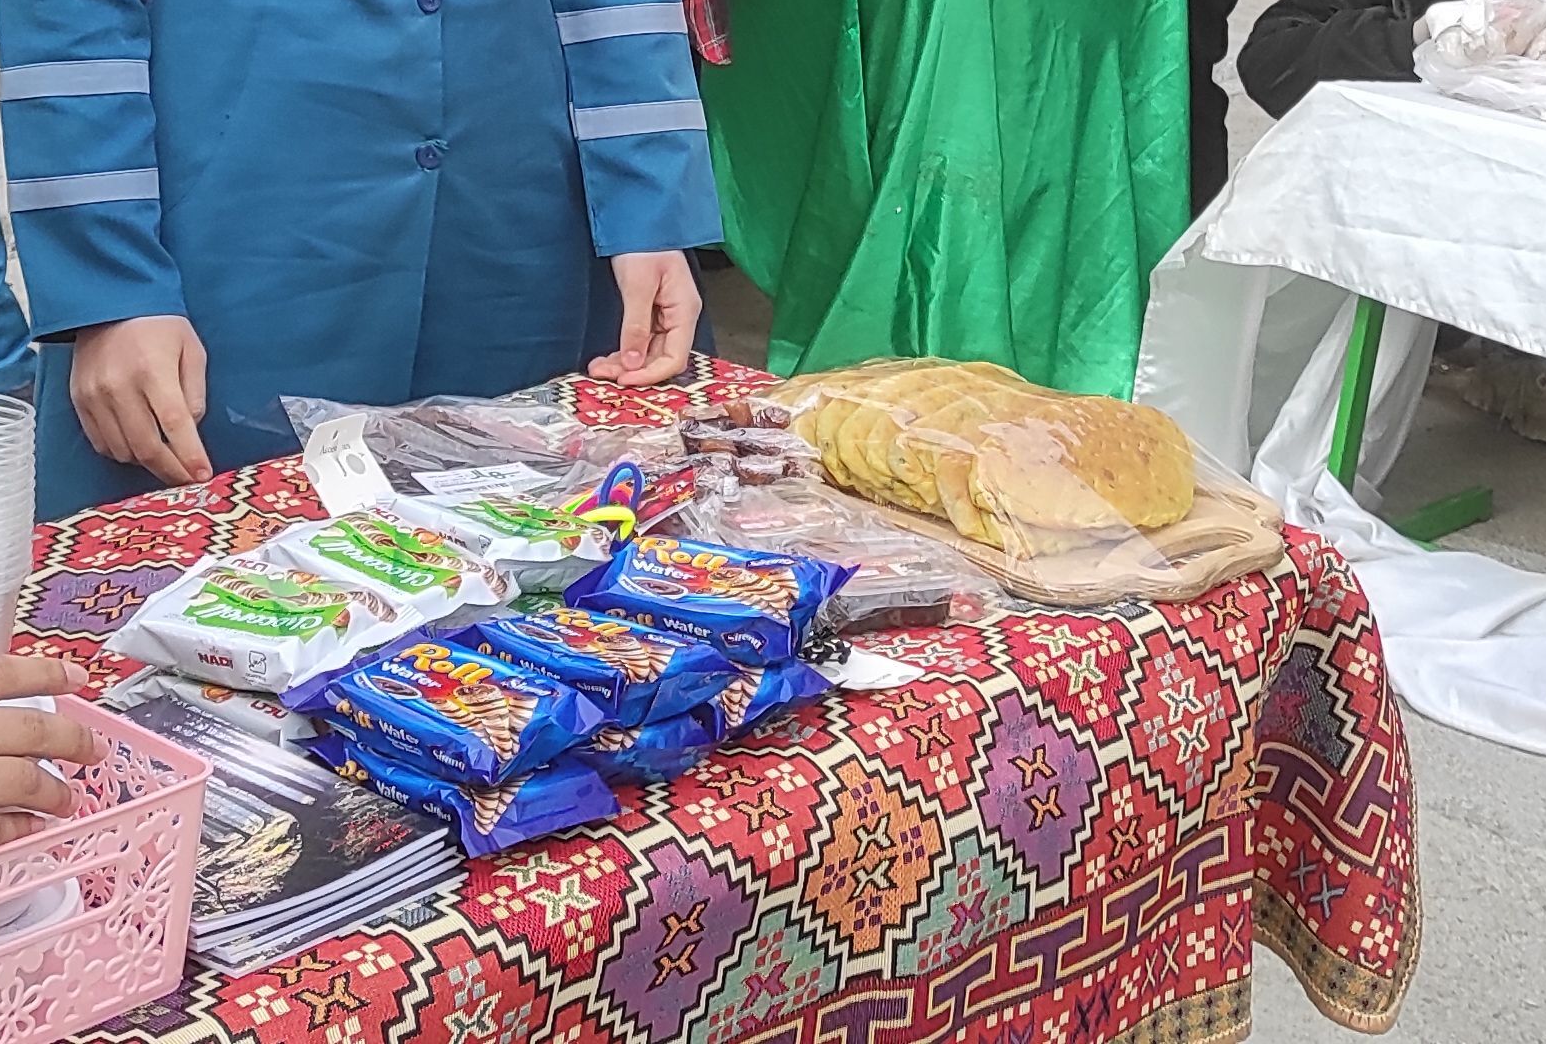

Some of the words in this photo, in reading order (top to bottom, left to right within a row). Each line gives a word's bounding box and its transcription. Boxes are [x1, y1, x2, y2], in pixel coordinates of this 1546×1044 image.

[634, 536, 729, 571] Roll
[632, 558, 697, 581] Wafer
[662, 616, 711, 637] Wafer
[380, 660, 443, 689] Wafer
[394, 642, 494, 686] Roll
[378, 718, 421, 746] Wafer
